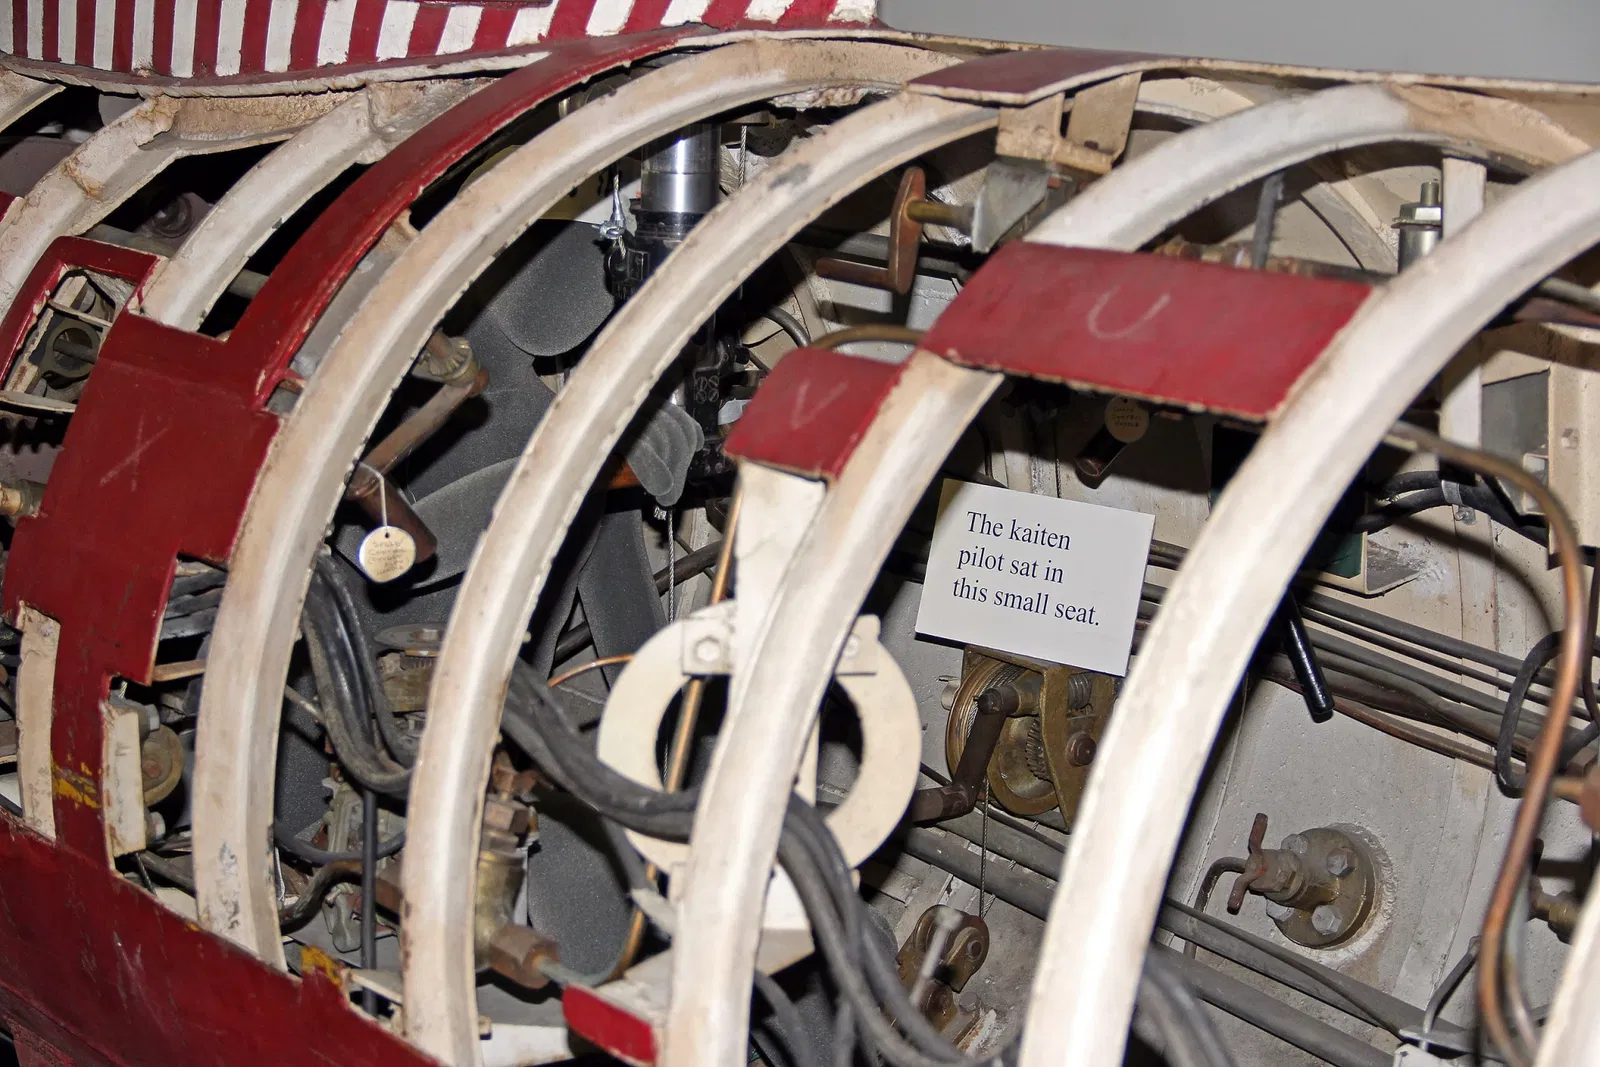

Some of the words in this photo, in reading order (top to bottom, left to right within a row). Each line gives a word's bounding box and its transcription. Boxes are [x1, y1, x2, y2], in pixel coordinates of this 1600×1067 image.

[967, 511, 1004, 538] The
[1008, 518, 1071, 551] kaiten
[956, 545, 1005, 572] pilot
[1009, 558, 1039, 579] sat
[1043, 559, 1064, 584] in
[952, 577, 988, 603] this
[993, 591, 1050, 616] small
[1054, 603, 1100, 627] seat.
